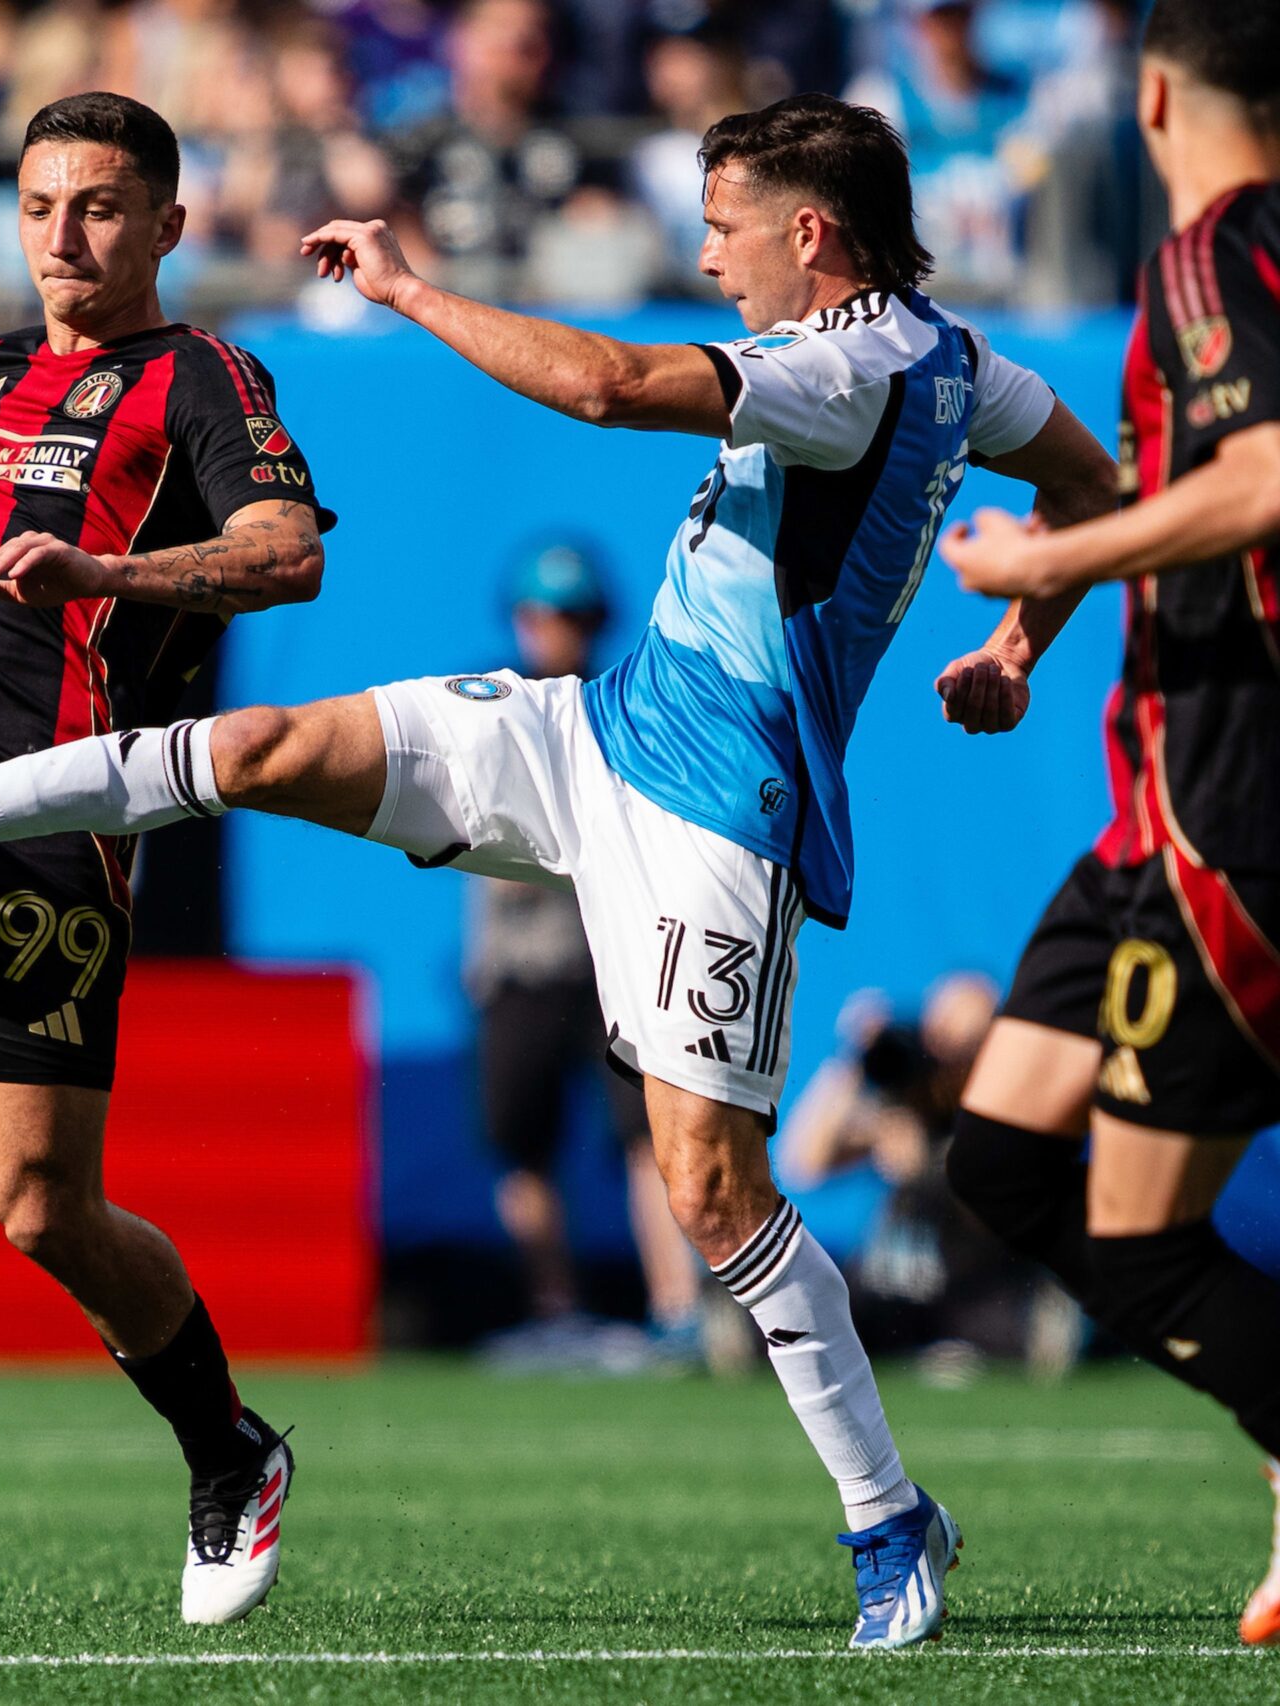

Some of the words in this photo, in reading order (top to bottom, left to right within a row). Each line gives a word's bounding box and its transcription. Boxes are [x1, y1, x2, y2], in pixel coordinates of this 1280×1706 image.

[250, 420, 273, 429] MLS
[14, 445, 89, 467] FAMILY
[276, 462, 306, 487] tv
[656, 916, 756, 1026] 13
[1098, 938, 1178, 1049] 0
